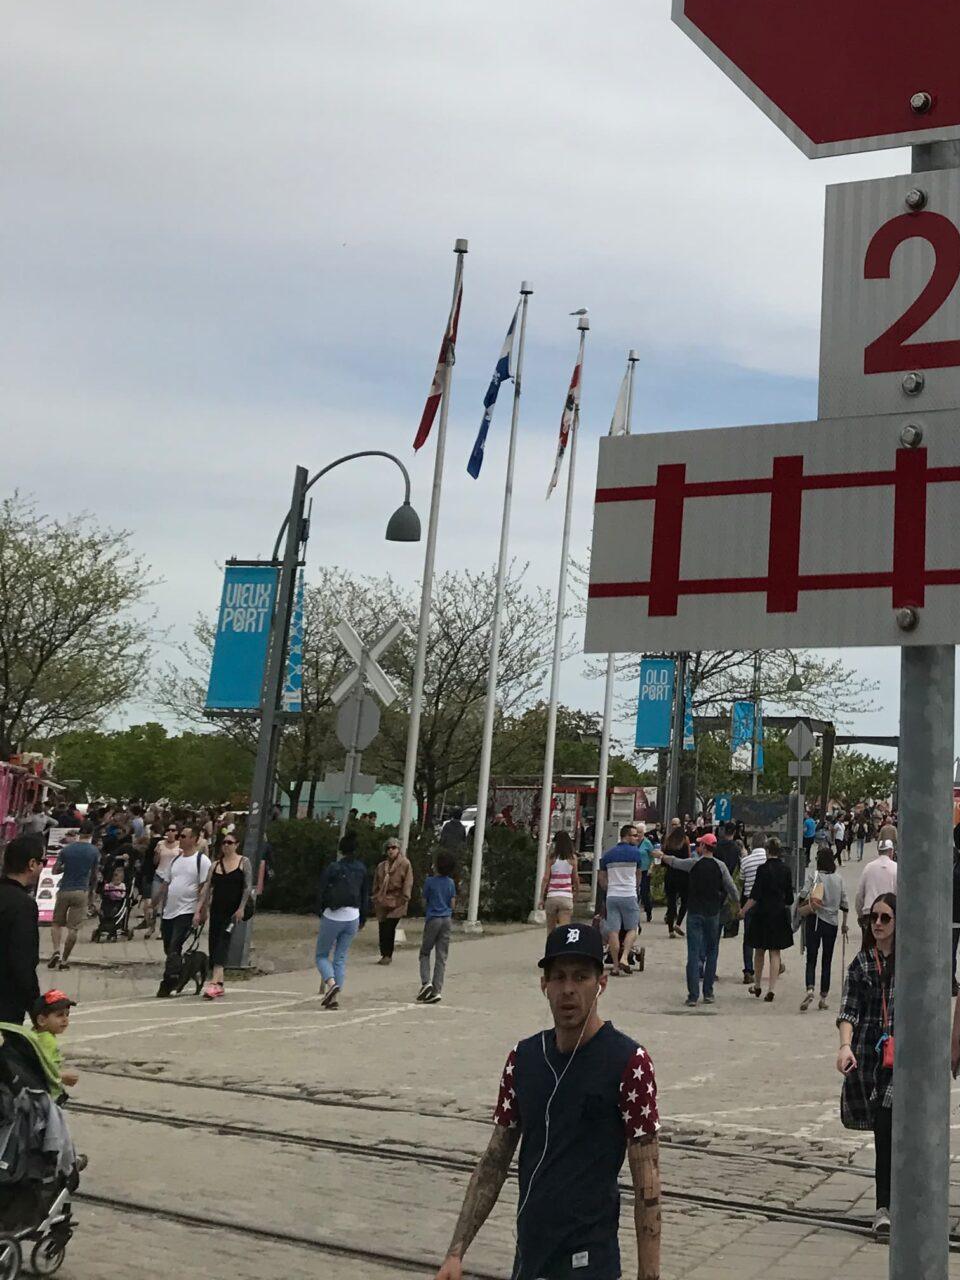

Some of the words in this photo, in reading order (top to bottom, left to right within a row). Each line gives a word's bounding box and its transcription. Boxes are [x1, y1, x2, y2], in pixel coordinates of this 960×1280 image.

[225, 583, 272, 609] VIEUX
[221, 607, 269, 633] PORT
[645, 669, 669, 685] OLD
[641, 684, 671, 701] PORT
